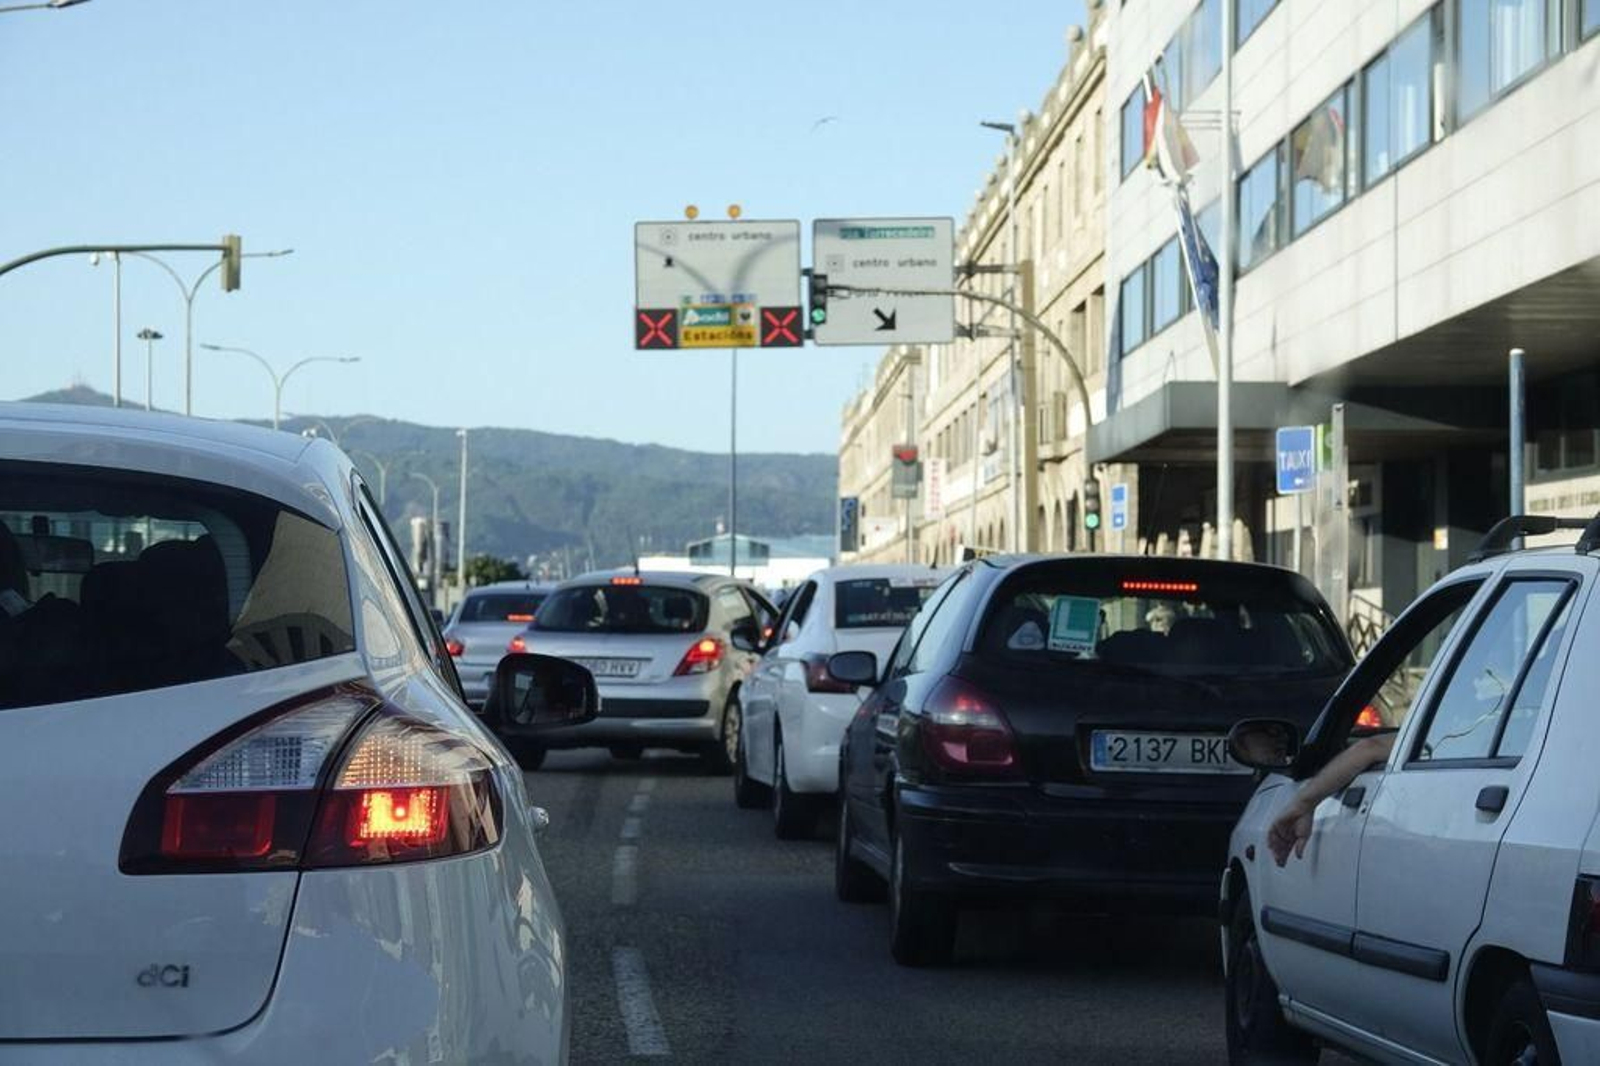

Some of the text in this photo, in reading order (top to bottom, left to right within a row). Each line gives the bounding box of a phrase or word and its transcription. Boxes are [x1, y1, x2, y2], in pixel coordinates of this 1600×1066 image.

[853, 255, 938, 268] centro urbano
[1280, 448, 1312, 472] TAXI
[1112, 737, 1178, 763] 2137
[137, 962, 190, 988] dCi
